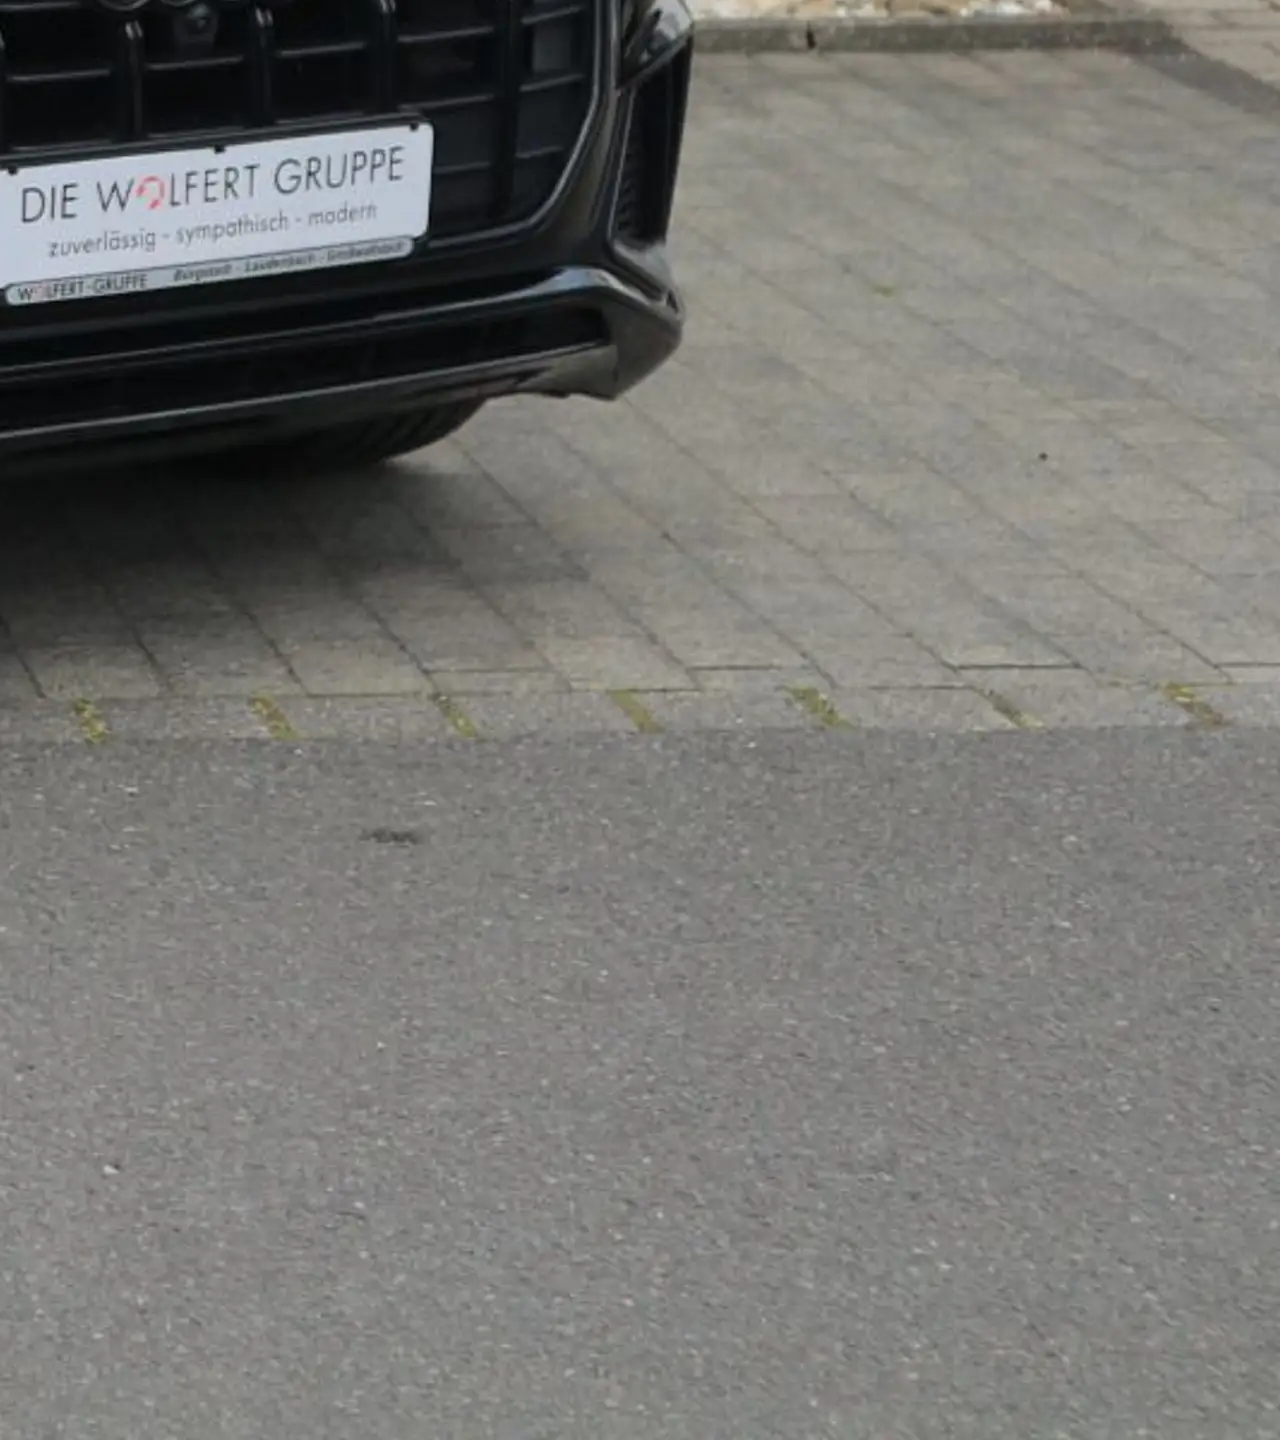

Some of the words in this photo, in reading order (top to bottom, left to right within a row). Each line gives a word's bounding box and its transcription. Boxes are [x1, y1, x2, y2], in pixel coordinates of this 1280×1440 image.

[21, 183, 79, 224] DIE
[96, 164, 261, 212] WOLFERT
[274, 146, 406, 195] GRUPPE
[48, 229, 157, 259] zuverlässig
[175, 213, 290, 247] sympathisch
[307, 201, 378, 226] modern
